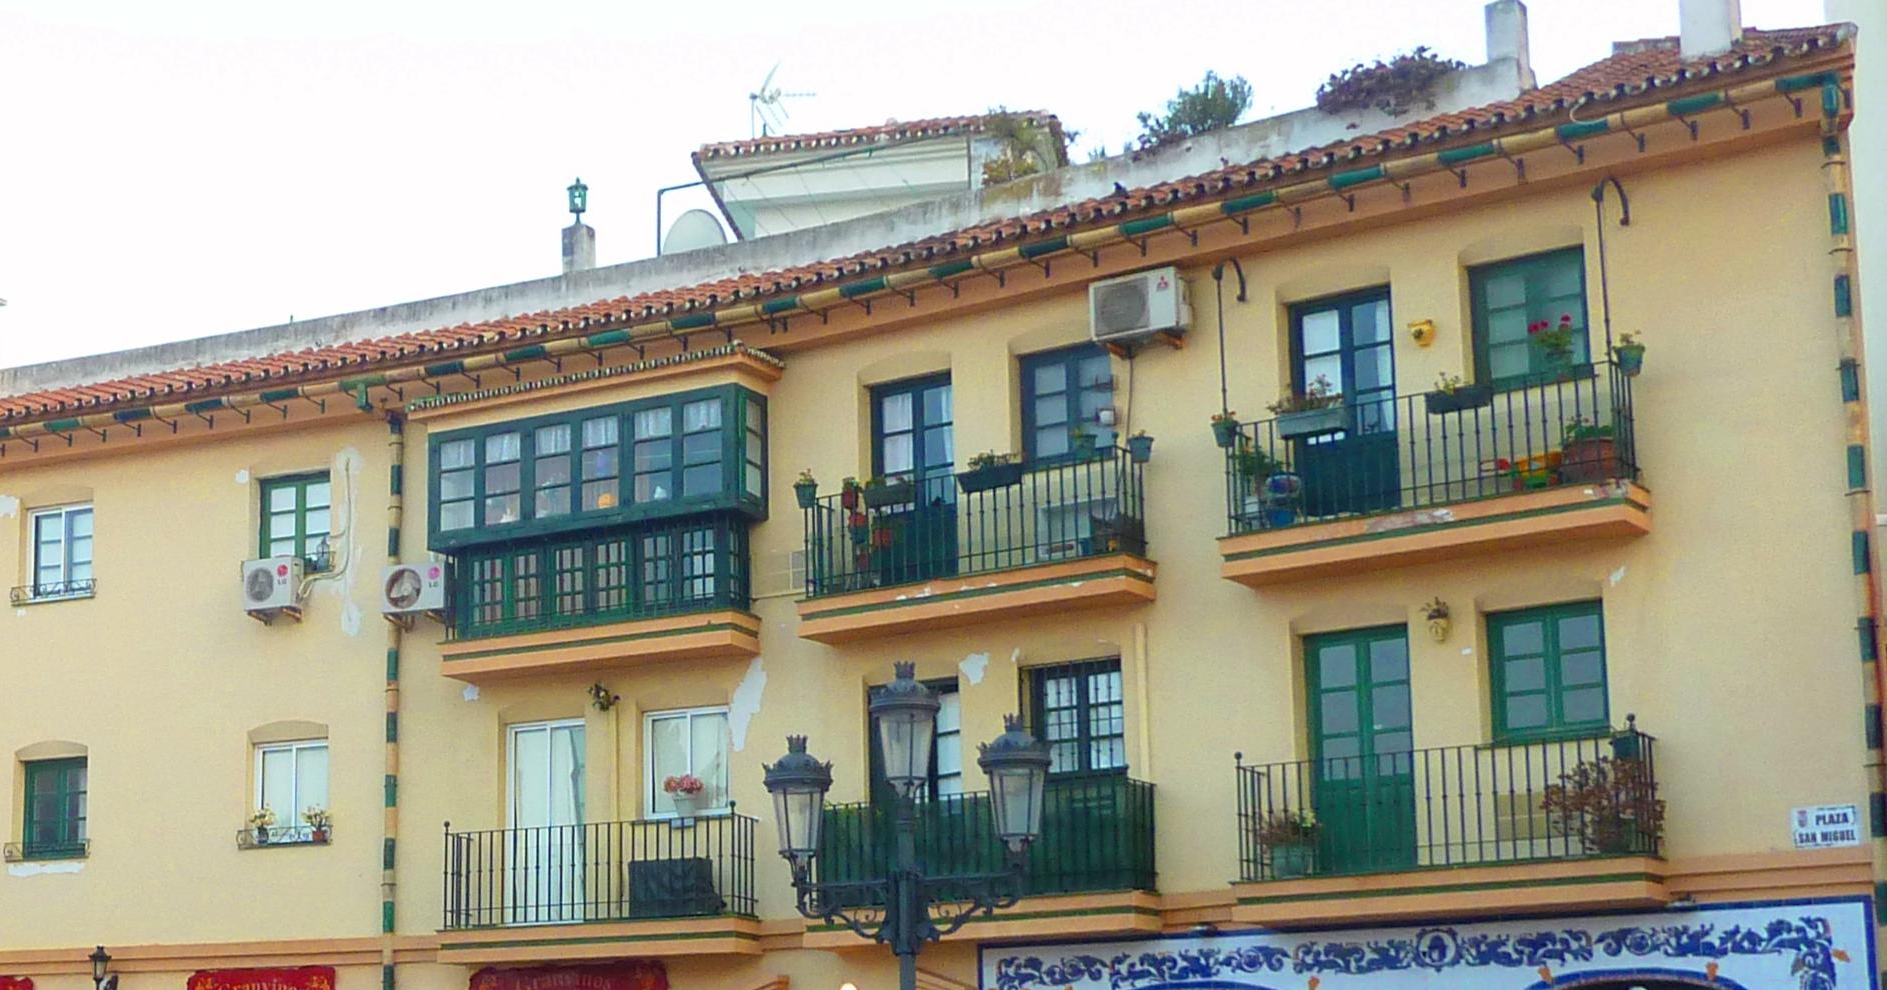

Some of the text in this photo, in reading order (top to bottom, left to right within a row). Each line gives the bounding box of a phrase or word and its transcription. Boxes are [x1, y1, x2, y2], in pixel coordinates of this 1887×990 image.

[1815, 813, 1849, 826] PLAZA
[1798, 830, 1856, 844] SAN MIGUEL
